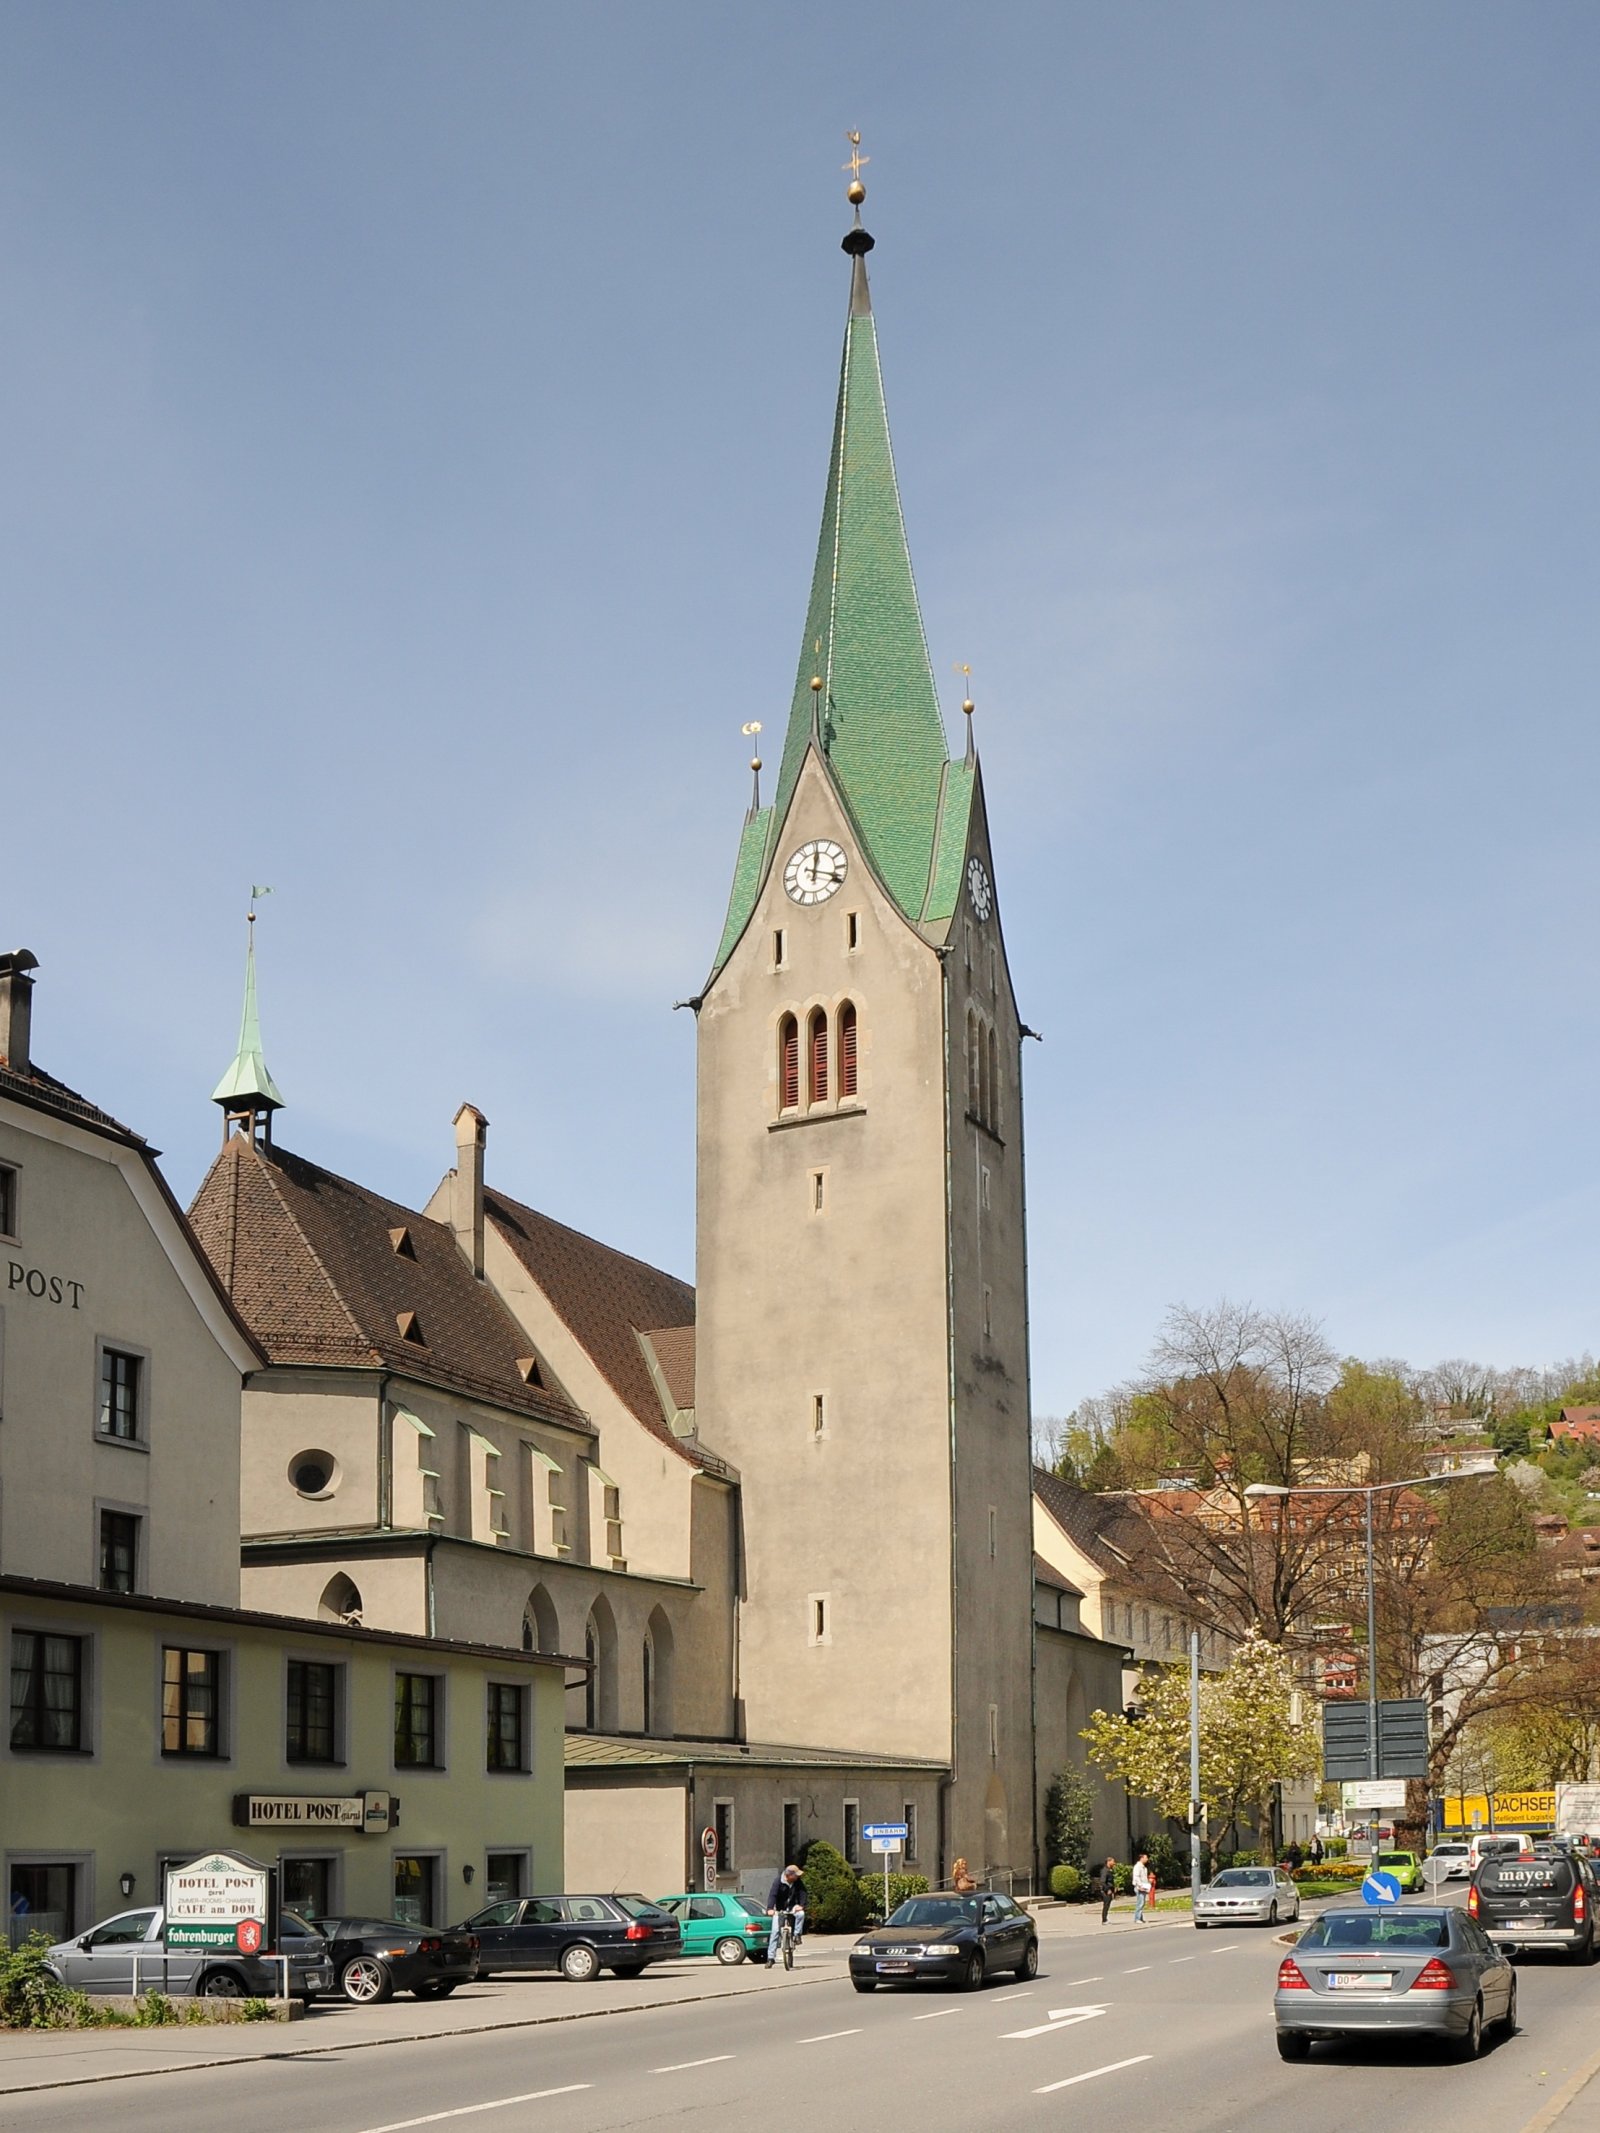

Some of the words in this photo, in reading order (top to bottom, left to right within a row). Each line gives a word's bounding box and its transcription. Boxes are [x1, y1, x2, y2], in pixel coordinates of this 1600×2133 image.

[8, 1261, 84, 1309] POST
[251, 1802, 301, 1820] HOTEL
[306, 1803, 341, 1820] POST
[341, 1810, 361, 1822] garni
[1494, 1797, 1556, 1812] DACHSER
[1527, 1813, 1556, 1822] Logistic
[178, 1878, 219, 1888] HOTEL
[225, 1878, 256, 1888] POST
[1497, 1870, 1554, 1886] mayer
[178, 1904, 206, 1914] CAFE
[210, 1906, 225, 1914] am
[231, 1904, 255, 1914] DOM
